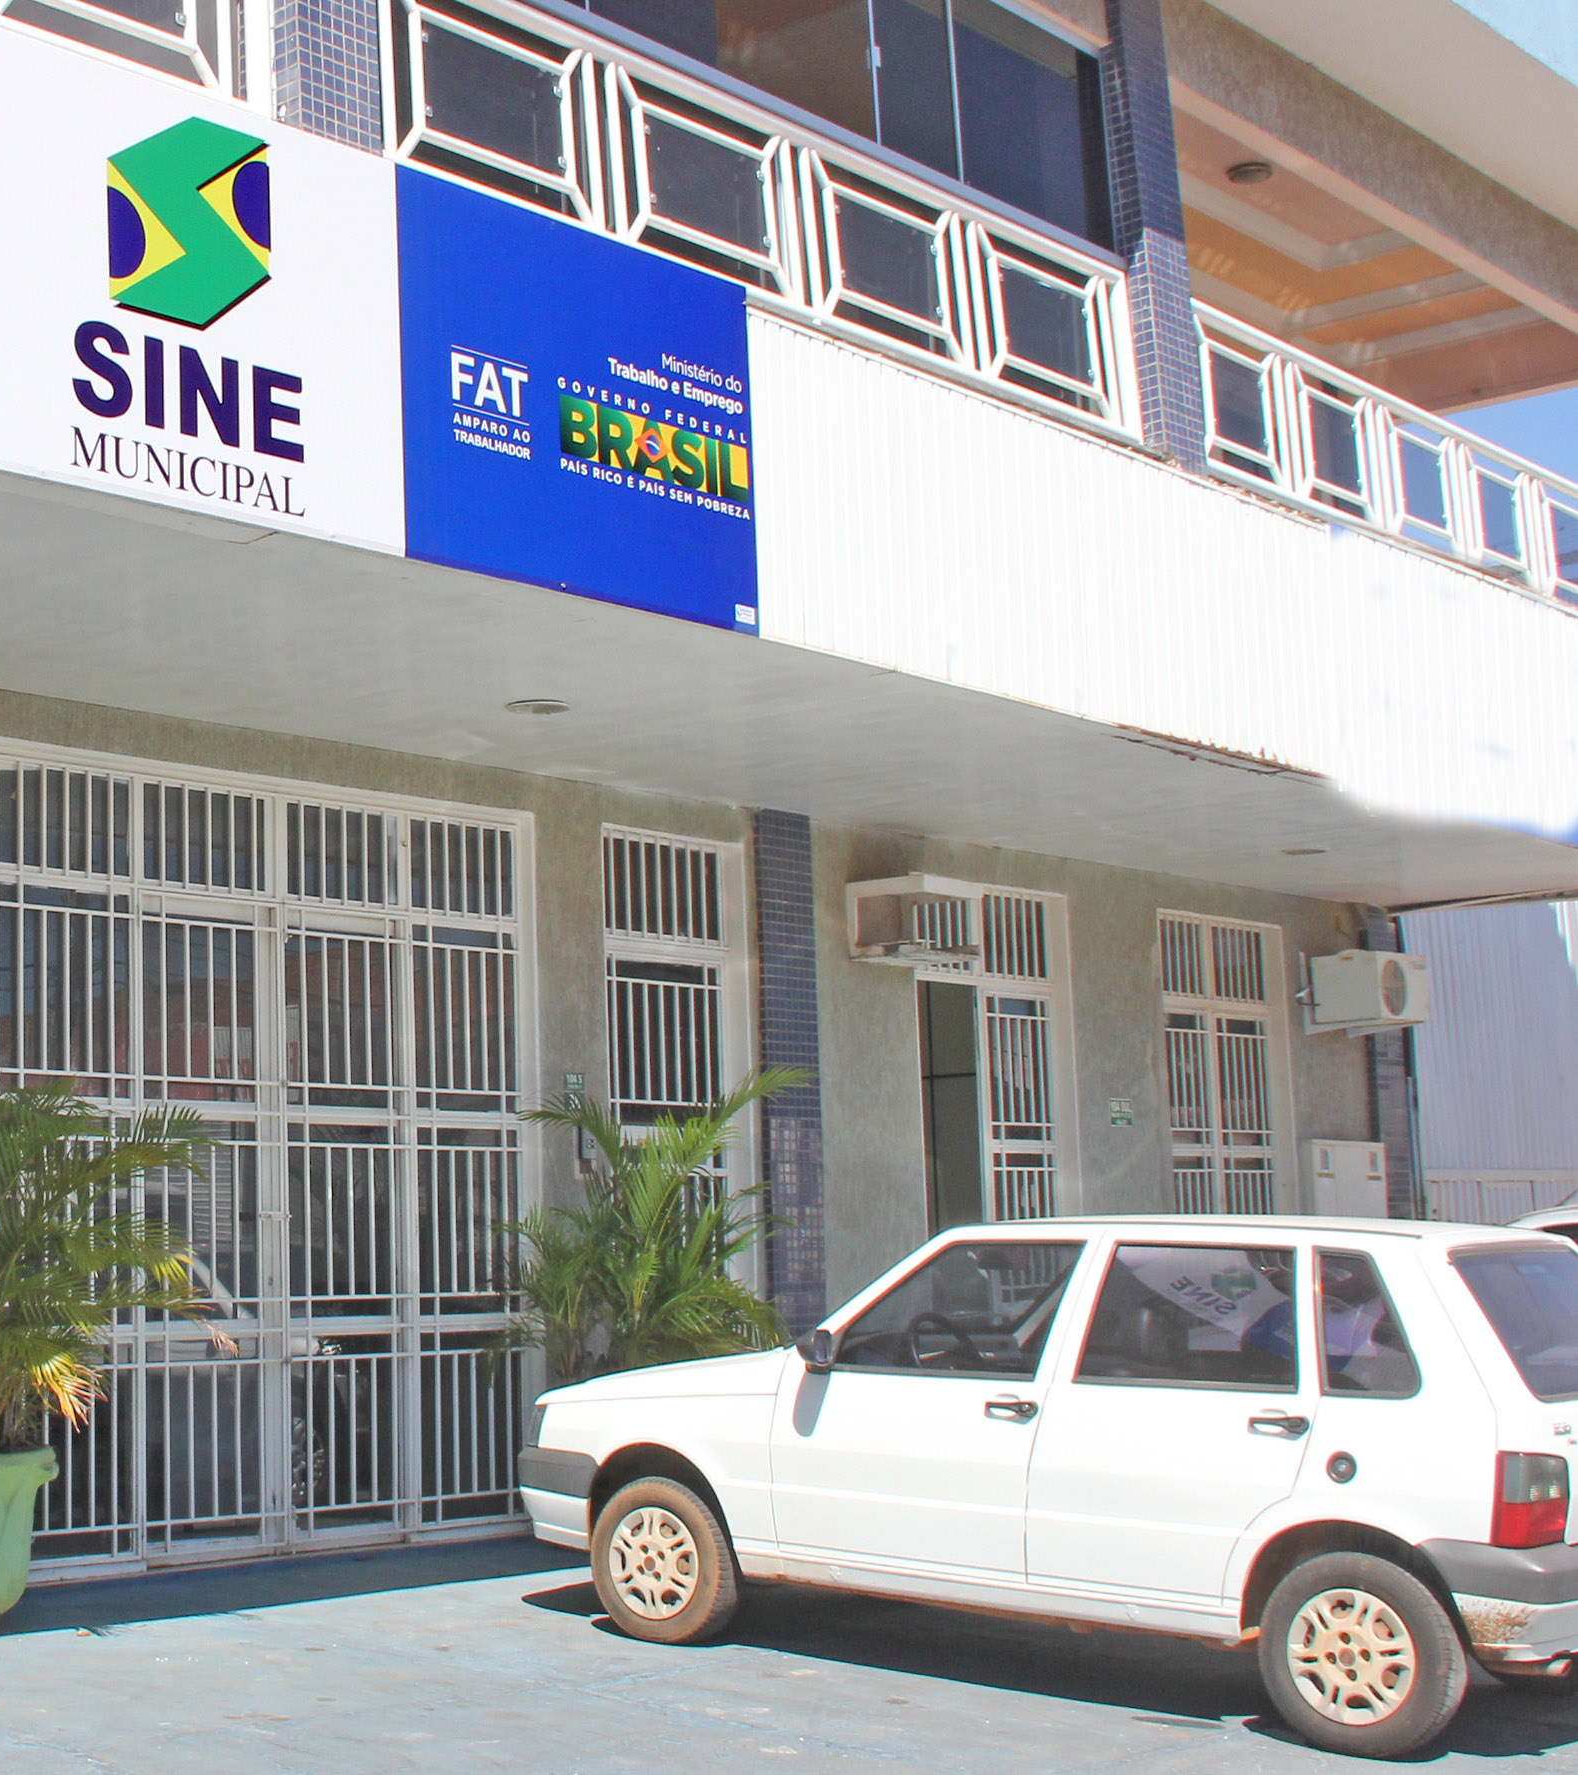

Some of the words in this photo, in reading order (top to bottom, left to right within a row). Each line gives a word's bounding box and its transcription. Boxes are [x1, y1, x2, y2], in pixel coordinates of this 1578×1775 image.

[72, 320, 304, 463] SINE
[451, 351, 528, 417] FAT
[607, 357, 668, 391] Trabalho
[671, 381, 680, 395] e
[683, 381, 743, 415] Emprego
[661, 353, 723, 387] Ministério
[725, 375, 742, 394] do
[453, 412, 508, 437] AMPARO
[513, 428, 531, 443] AO
[557, 376, 651, 414] GOVERNO
[665, 409, 747, 444] FEDERAL
[70, 425, 306, 517] MUNICIPAL
[453, 428, 531, 460] TRABALHADOR
[559, 393, 749, 503] BRASIL
[560, 458, 588, 476] PAÍS
[592, 466, 622, 485] RICO
[627, 475, 634, 489] É
[639, 479, 665, 497] PAÍS
[669, 488, 693, 504] SEM
[697, 495, 750, 520] POBREZA
